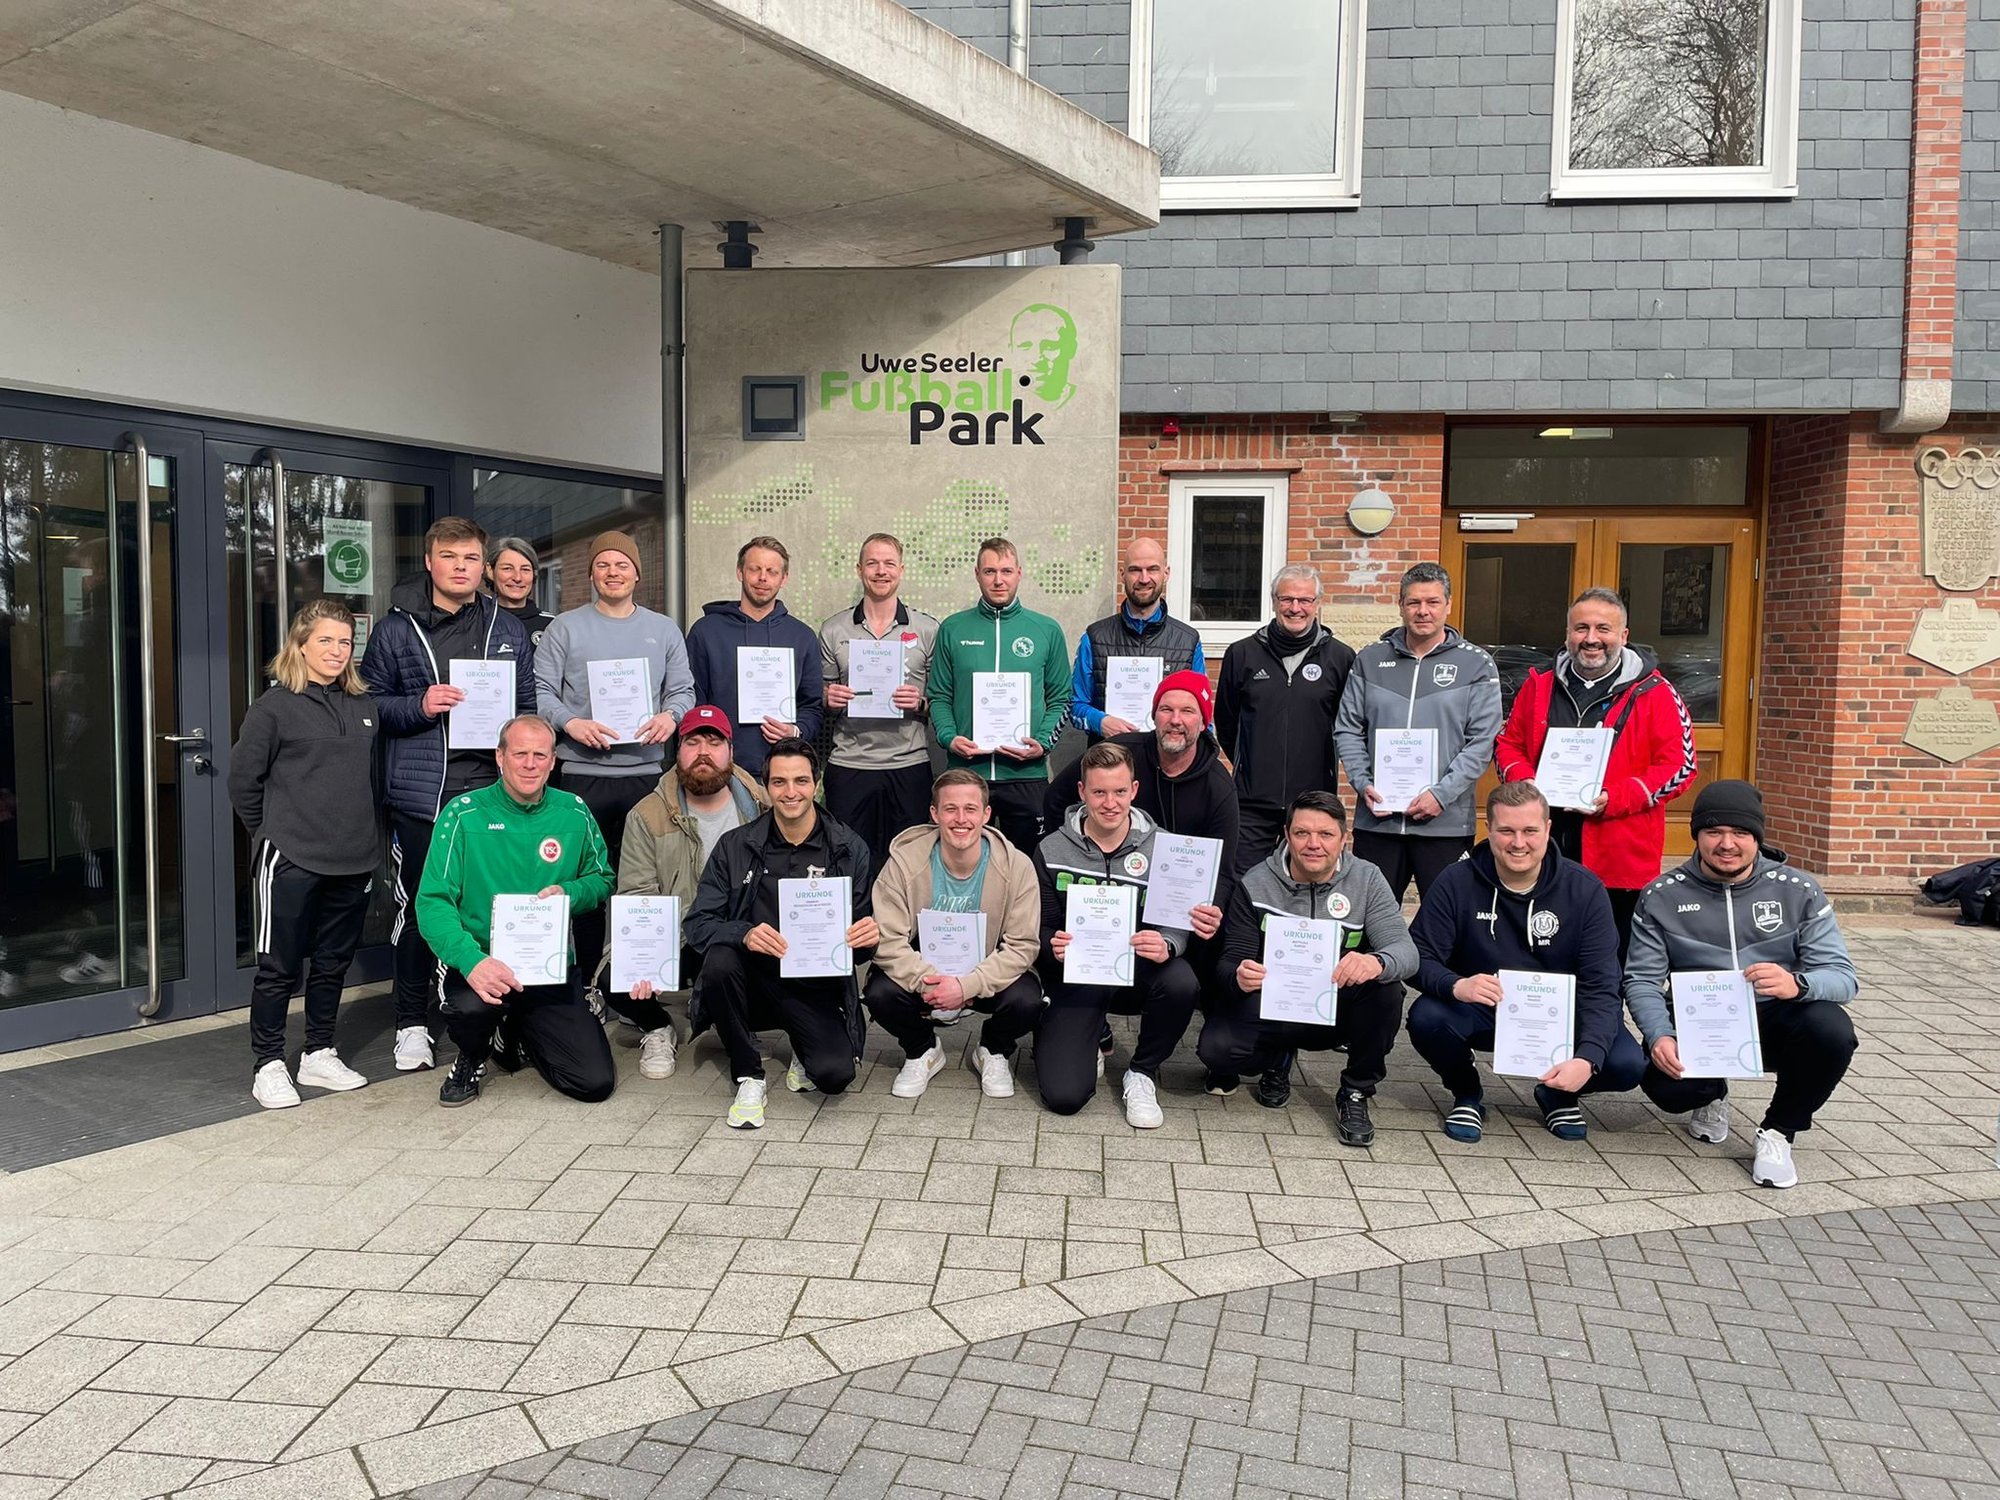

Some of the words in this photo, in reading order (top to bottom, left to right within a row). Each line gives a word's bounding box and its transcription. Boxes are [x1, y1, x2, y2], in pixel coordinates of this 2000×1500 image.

[861, 353, 917, 373] Uwe
[920, 351, 1003, 373] Seeler
[820, 368, 1013, 412] Fußball
[909, 398, 1045, 445] Park
[602, 669, 636, 677] URKUNDE
[1169, 846, 1207, 856] URKUNDE
[795, 890, 833, 898] URKUNDE
[1083, 897, 1121, 905] URKUNDE
[1677, 903, 1701, 913] JAKO
[1476, 911, 1498, 920] JAKO
[1283, 930, 1323, 940] URKUNDE
[1516, 984, 1557, 994] URKUNDE
[1690, 984, 1734, 992] URKUNDE
